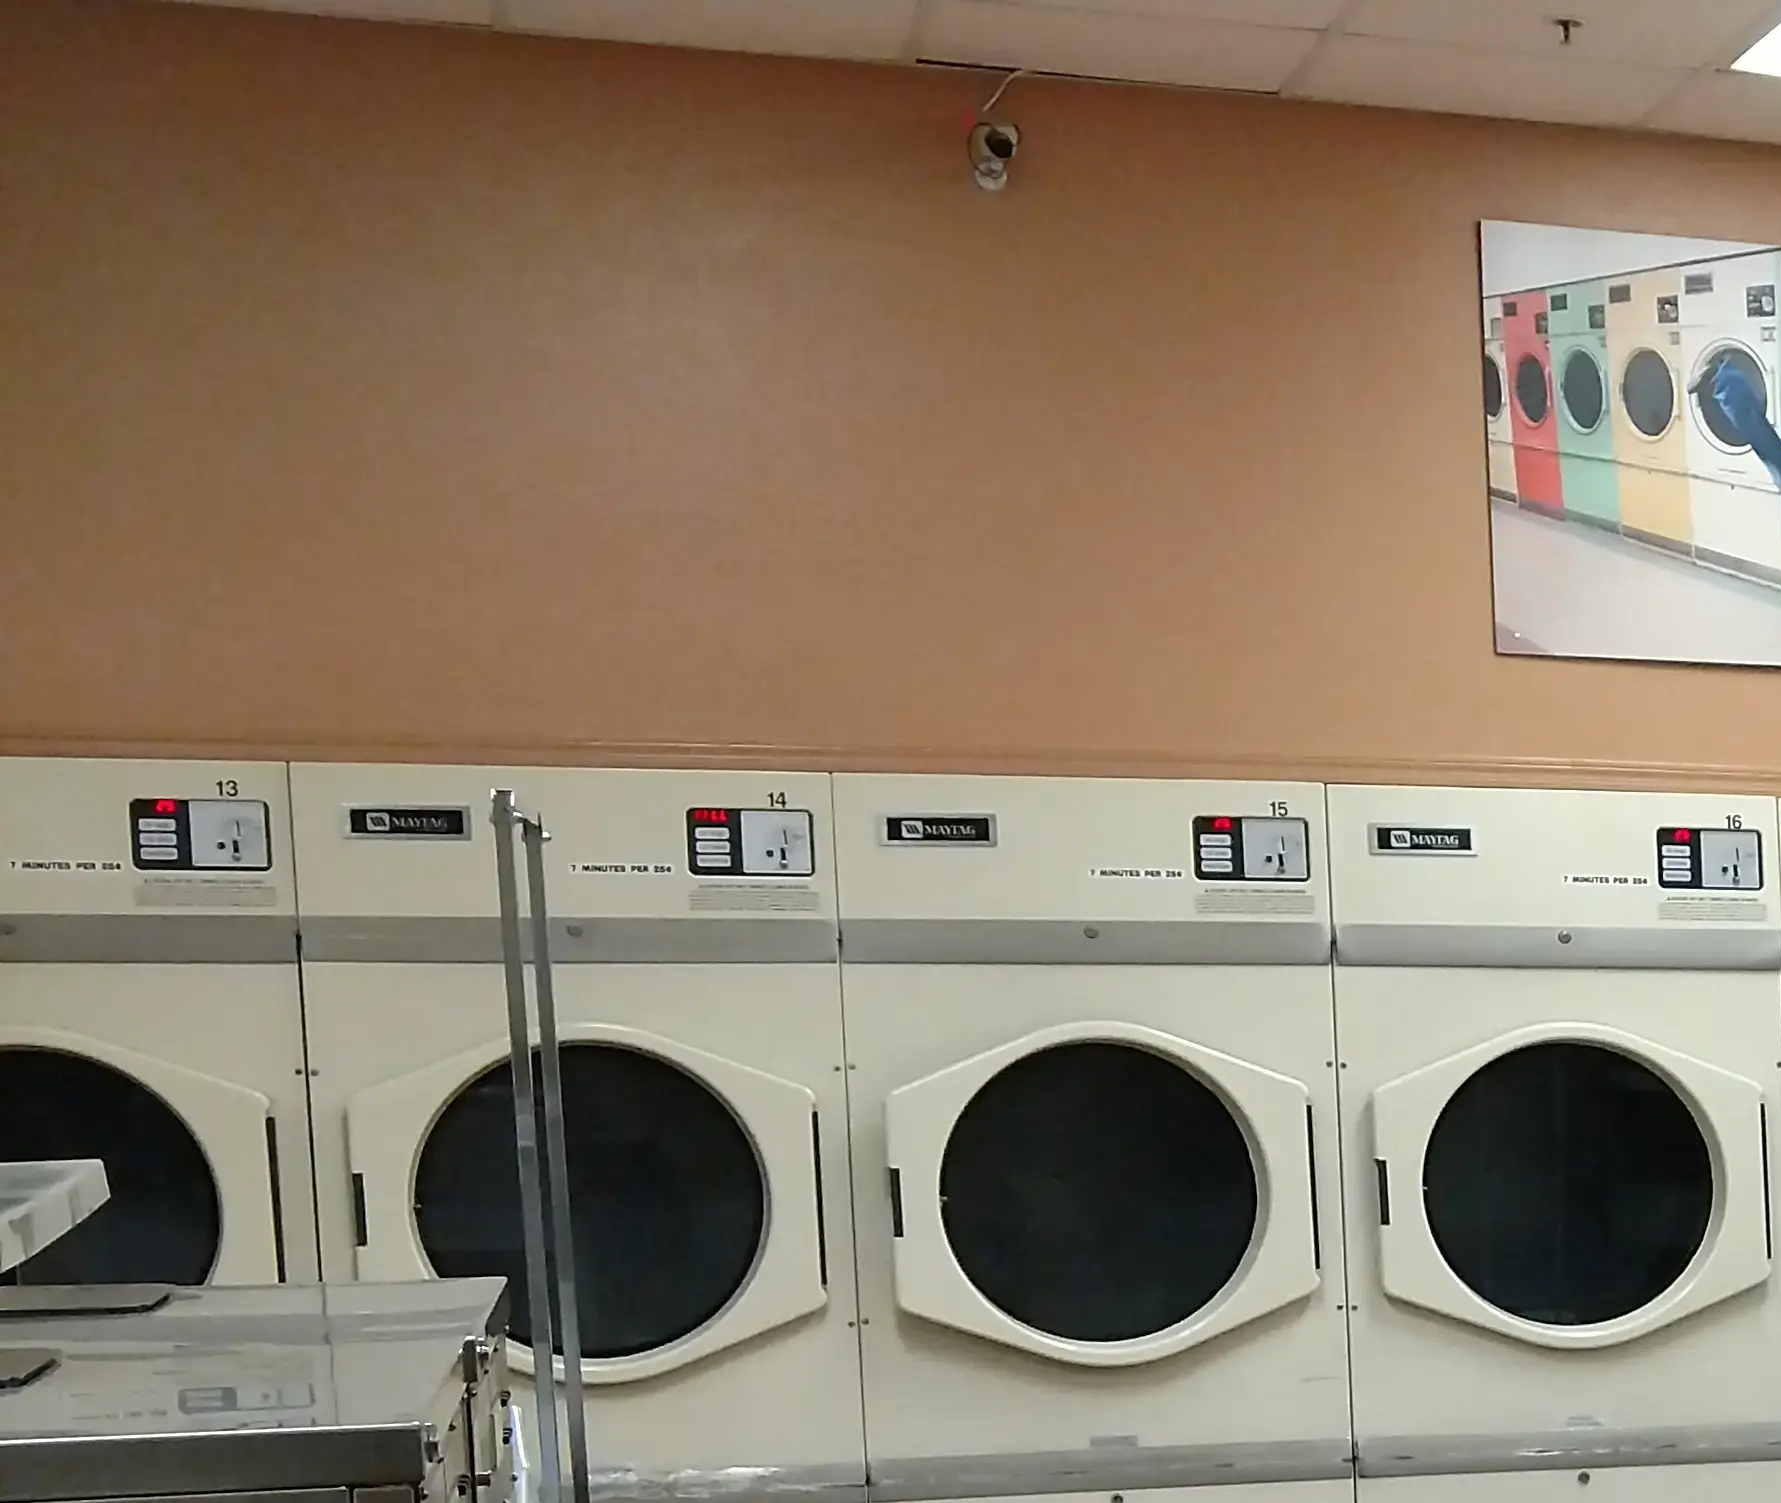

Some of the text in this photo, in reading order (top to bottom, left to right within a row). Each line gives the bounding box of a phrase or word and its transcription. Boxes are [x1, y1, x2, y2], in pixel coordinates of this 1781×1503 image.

[215, 780, 239, 797] 13
[767, 792, 787, 808] 14
[1269, 801, 1288, 817] 15
[924, 825, 976, 835] MAYTAG
[1725, 815, 1742, 830] 16
[1412, 835, 1459, 845] MAYTAG
[581, 865, 626, 873] MINUTES
